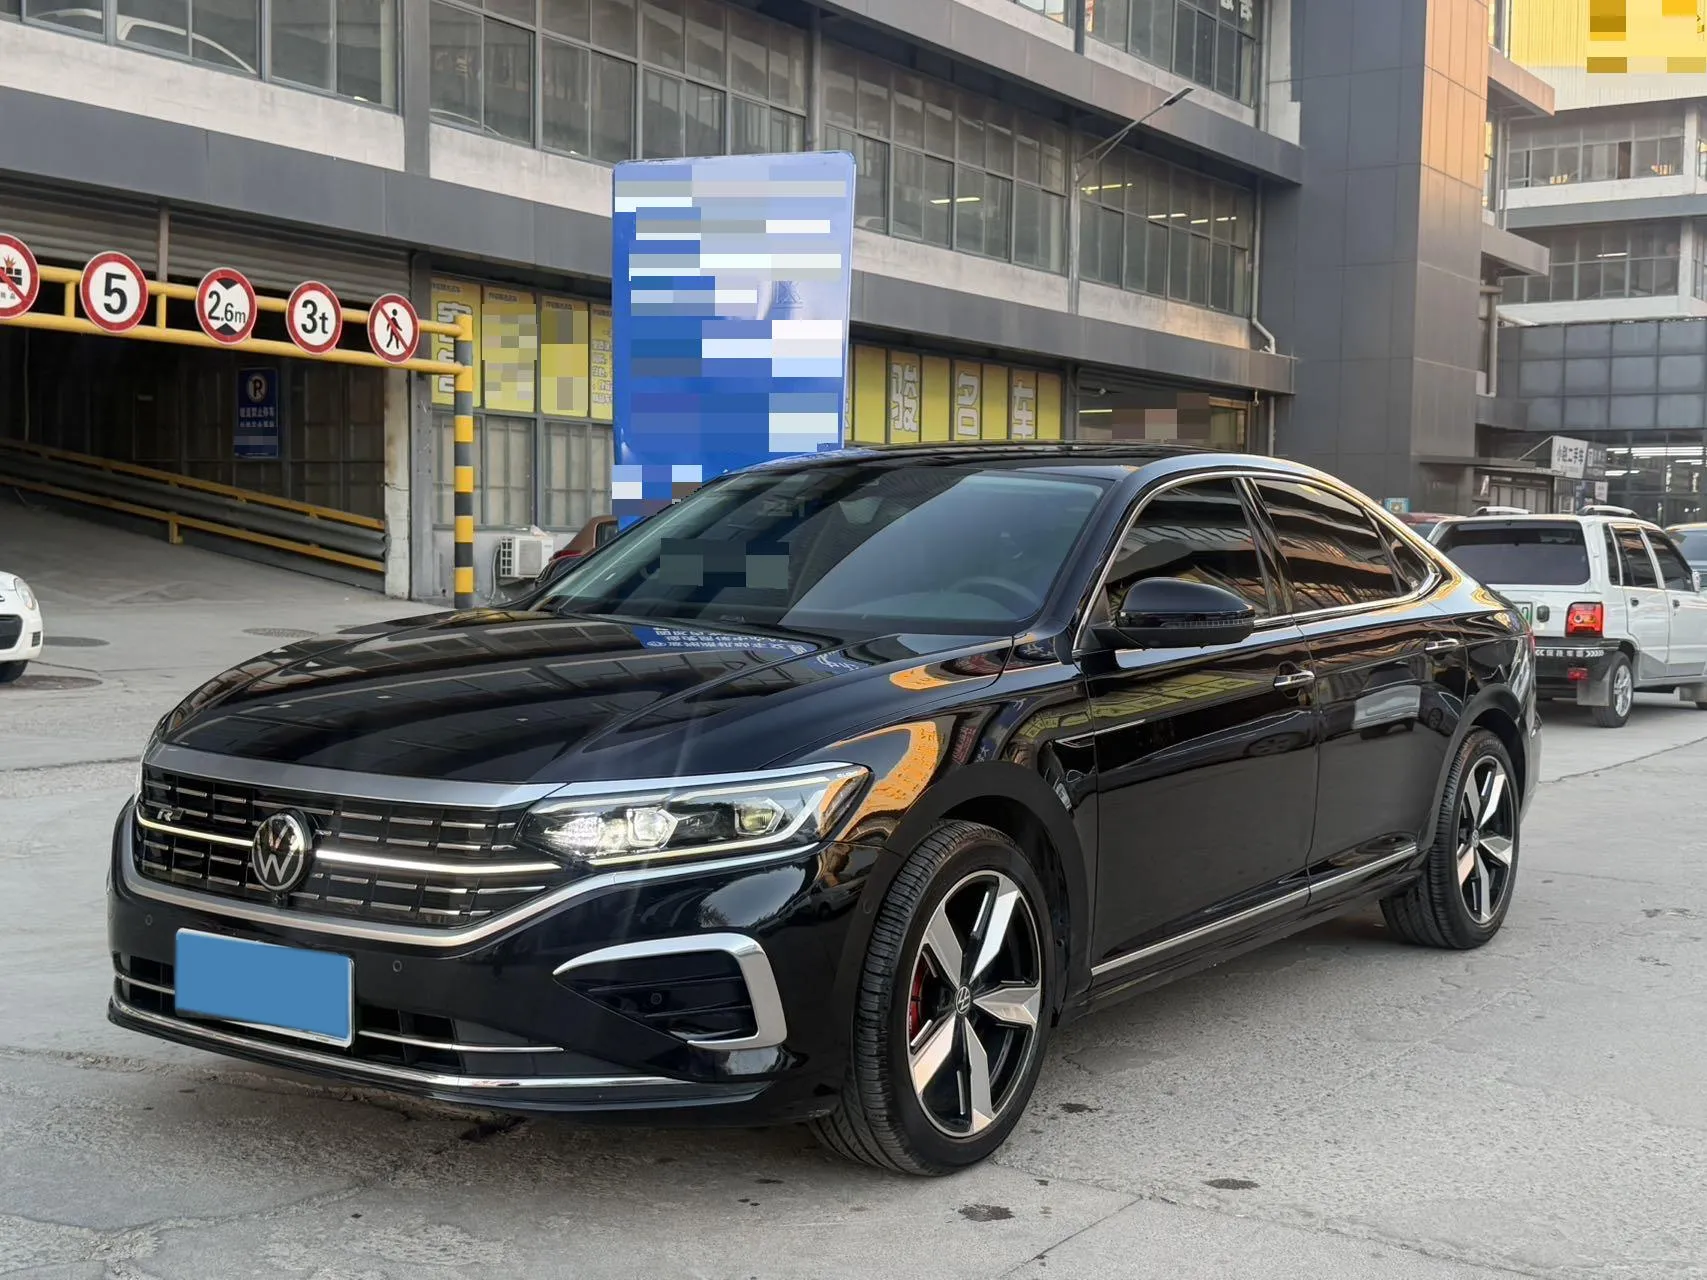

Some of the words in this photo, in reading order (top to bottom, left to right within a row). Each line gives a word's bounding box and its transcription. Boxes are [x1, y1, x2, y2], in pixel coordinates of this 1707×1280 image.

[104, 272, 127, 314] 5
[208, 290, 246, 323] 2.6m
[301, 299, 329, 334] 3t
